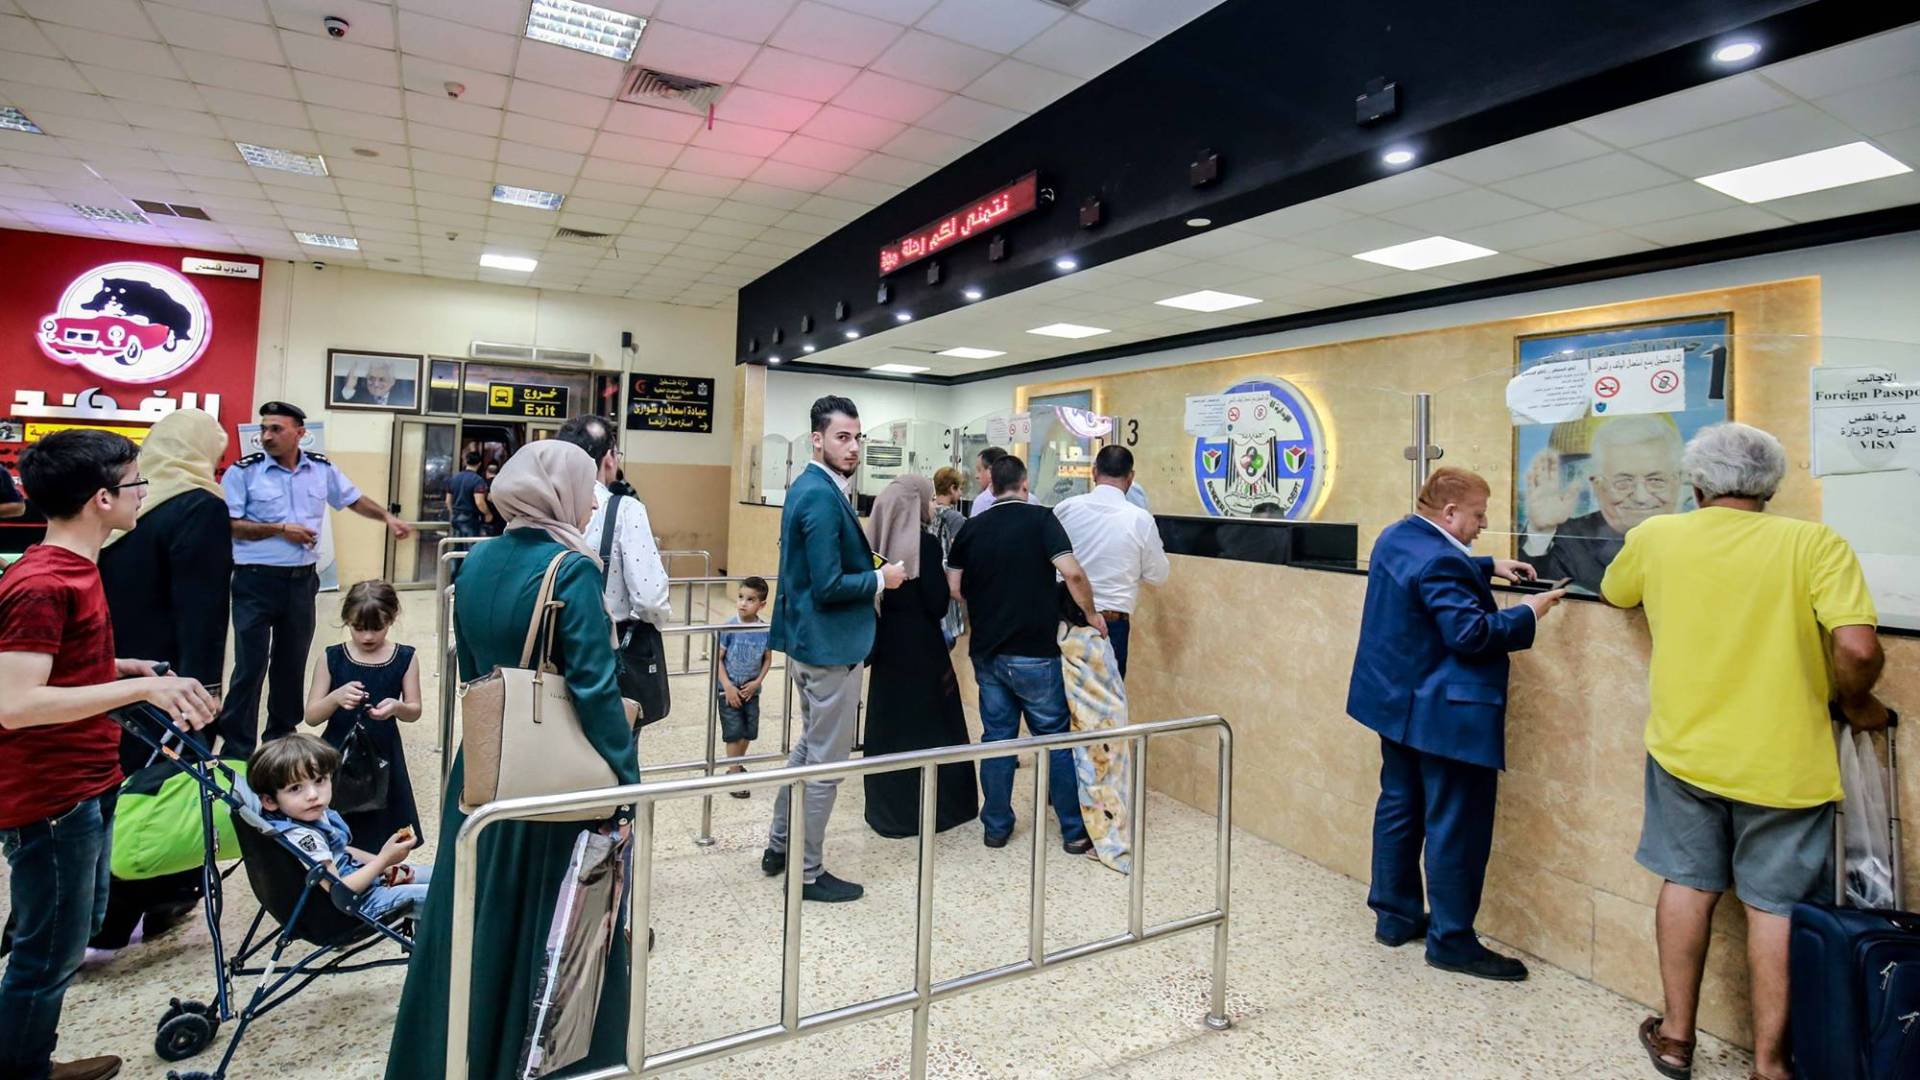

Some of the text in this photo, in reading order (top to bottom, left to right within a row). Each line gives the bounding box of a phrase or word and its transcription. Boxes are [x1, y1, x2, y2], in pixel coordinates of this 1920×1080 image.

[961, 194, 1008, 236] نتمنى
[929, 217, 956, 251] لكم
[1702, 346, 1726, 400] 1
[1857, 373, 1897, 385] الاجانب
[524, 388, 558, 400] خروج
[1815, 387, 1920, 401] Foreign Passpo
[525, 404, 556, 416] Exit
[687, 406, 707, 419] عيادة
[1848, 411, 1907, 424] هوية القدس
[1127, 419, 1139, 446] 3
[1840, 425, 1917, 438] تصاريح الزيارة
[1860, 440, 1896, 449] VISA
[1287, 481, 1301, 505] DEPT
